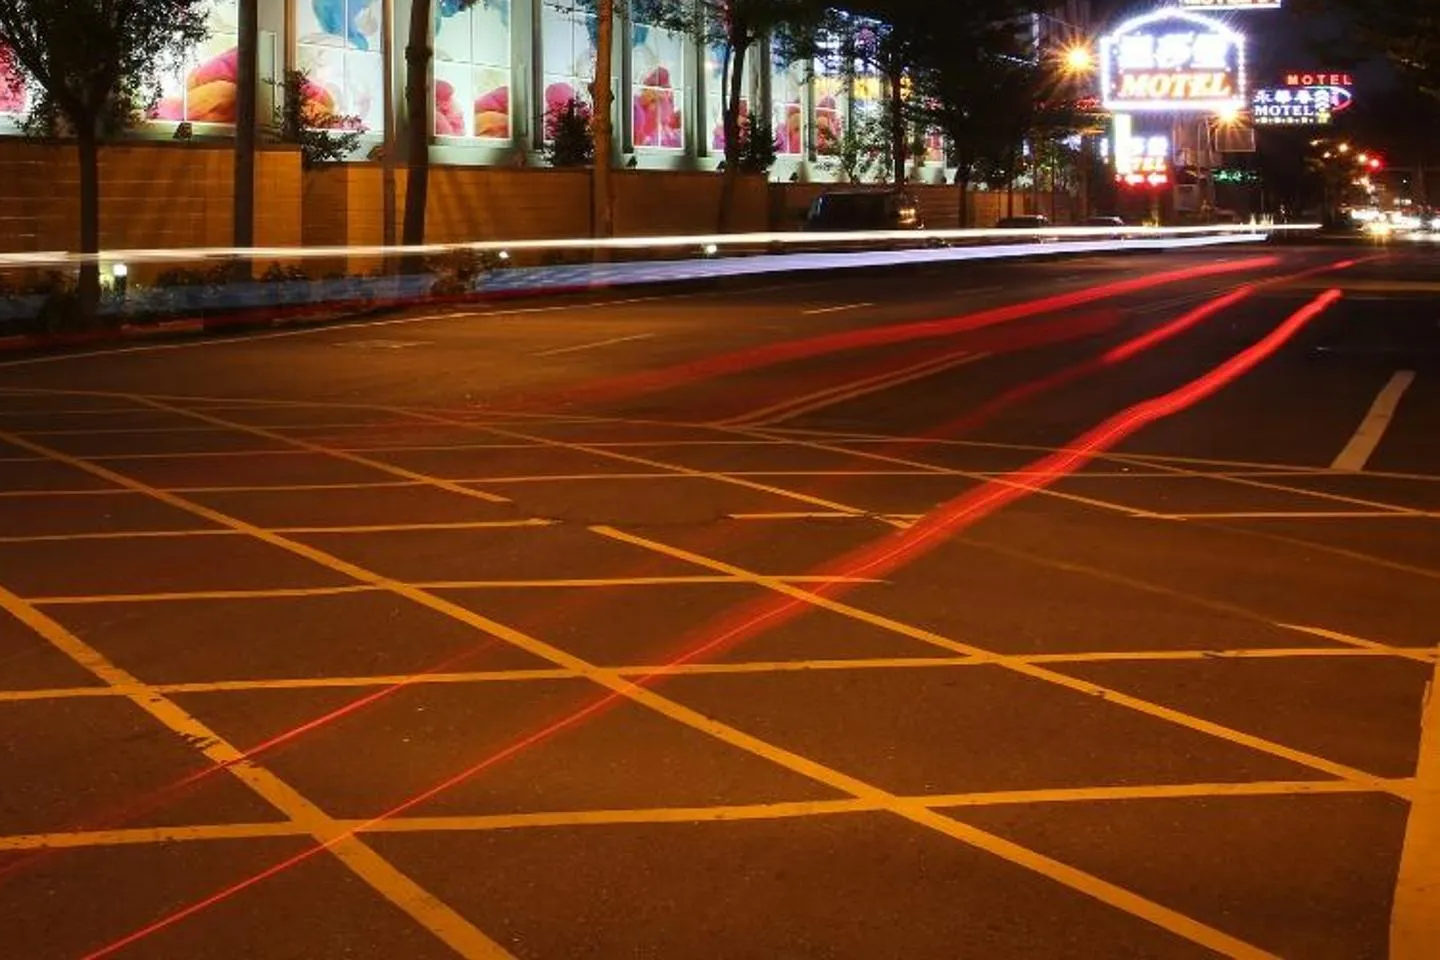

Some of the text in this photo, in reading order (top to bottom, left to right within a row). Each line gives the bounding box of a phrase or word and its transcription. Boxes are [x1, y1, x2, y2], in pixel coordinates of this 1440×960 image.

[1117, 72, 1232, 98] MOTEL
[1287, 74, 1353, 86] MOTEL
[1254, 105, 1314, 116] MOTEL
